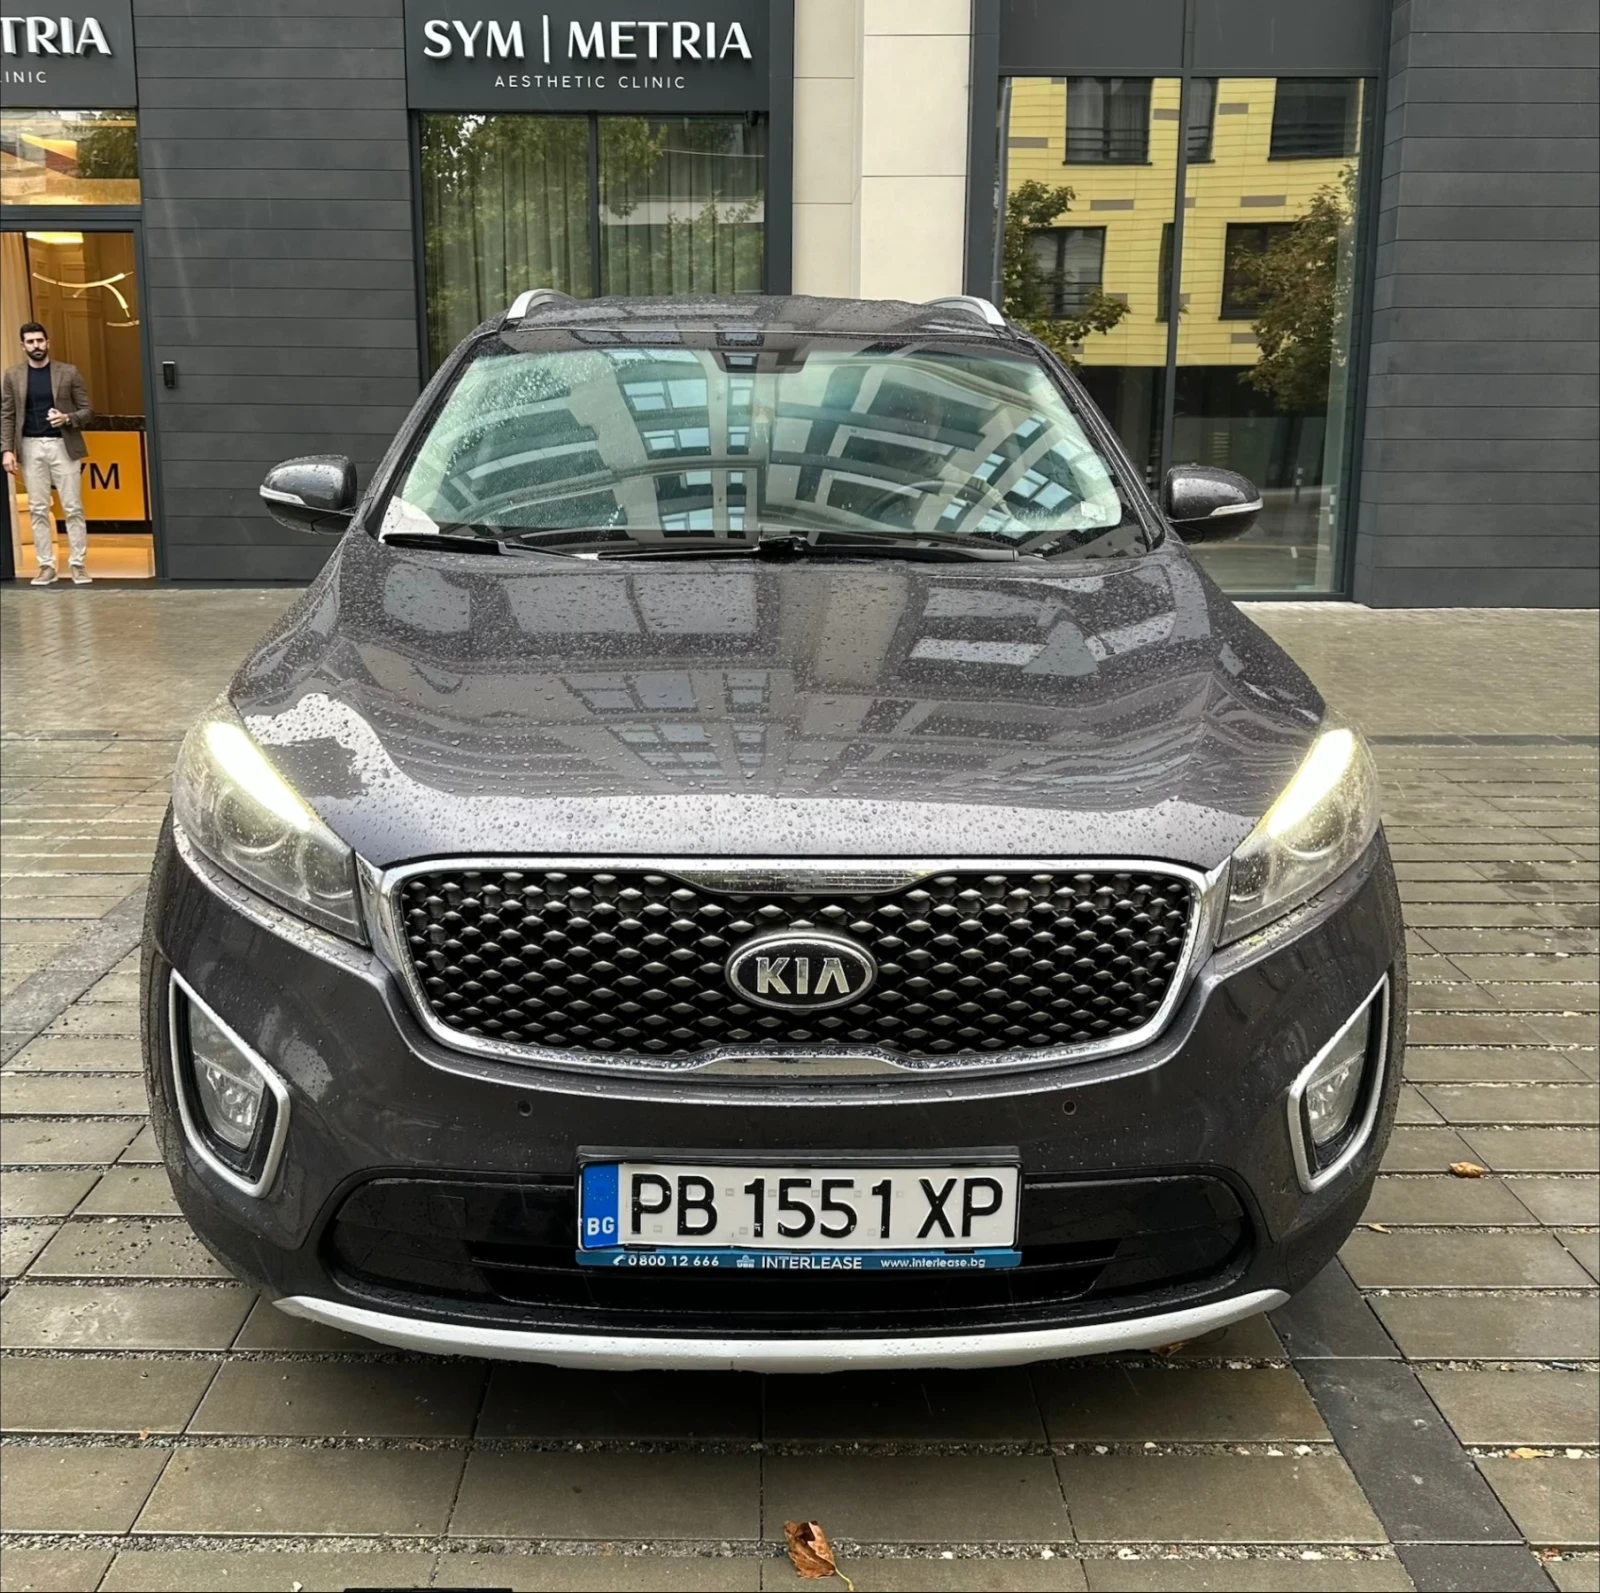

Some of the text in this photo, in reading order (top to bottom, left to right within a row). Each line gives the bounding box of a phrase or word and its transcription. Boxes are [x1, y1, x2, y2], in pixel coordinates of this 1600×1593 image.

[423, 19, 525, 59] SYM
[567, 21, 752, 59] METRIA
[0, 71, 47, 83] INIC
[494, 75, 685, 88] AESTHETIC CLINIC
[756, 957, 850, 994] KIA
[631, 1173, 1004, 1239] PB 1551 XP
[587, 1216, 615, 1235] BG
[628, 1256, 666, 1266] 0800
[671, 1256, 689, 1266] 12
[693, 1256, 719, 1266] 666
[762, 1256, 862, 1269] INTERLEASE
[880, 1258, 986, 1268] www.interlease.bg
